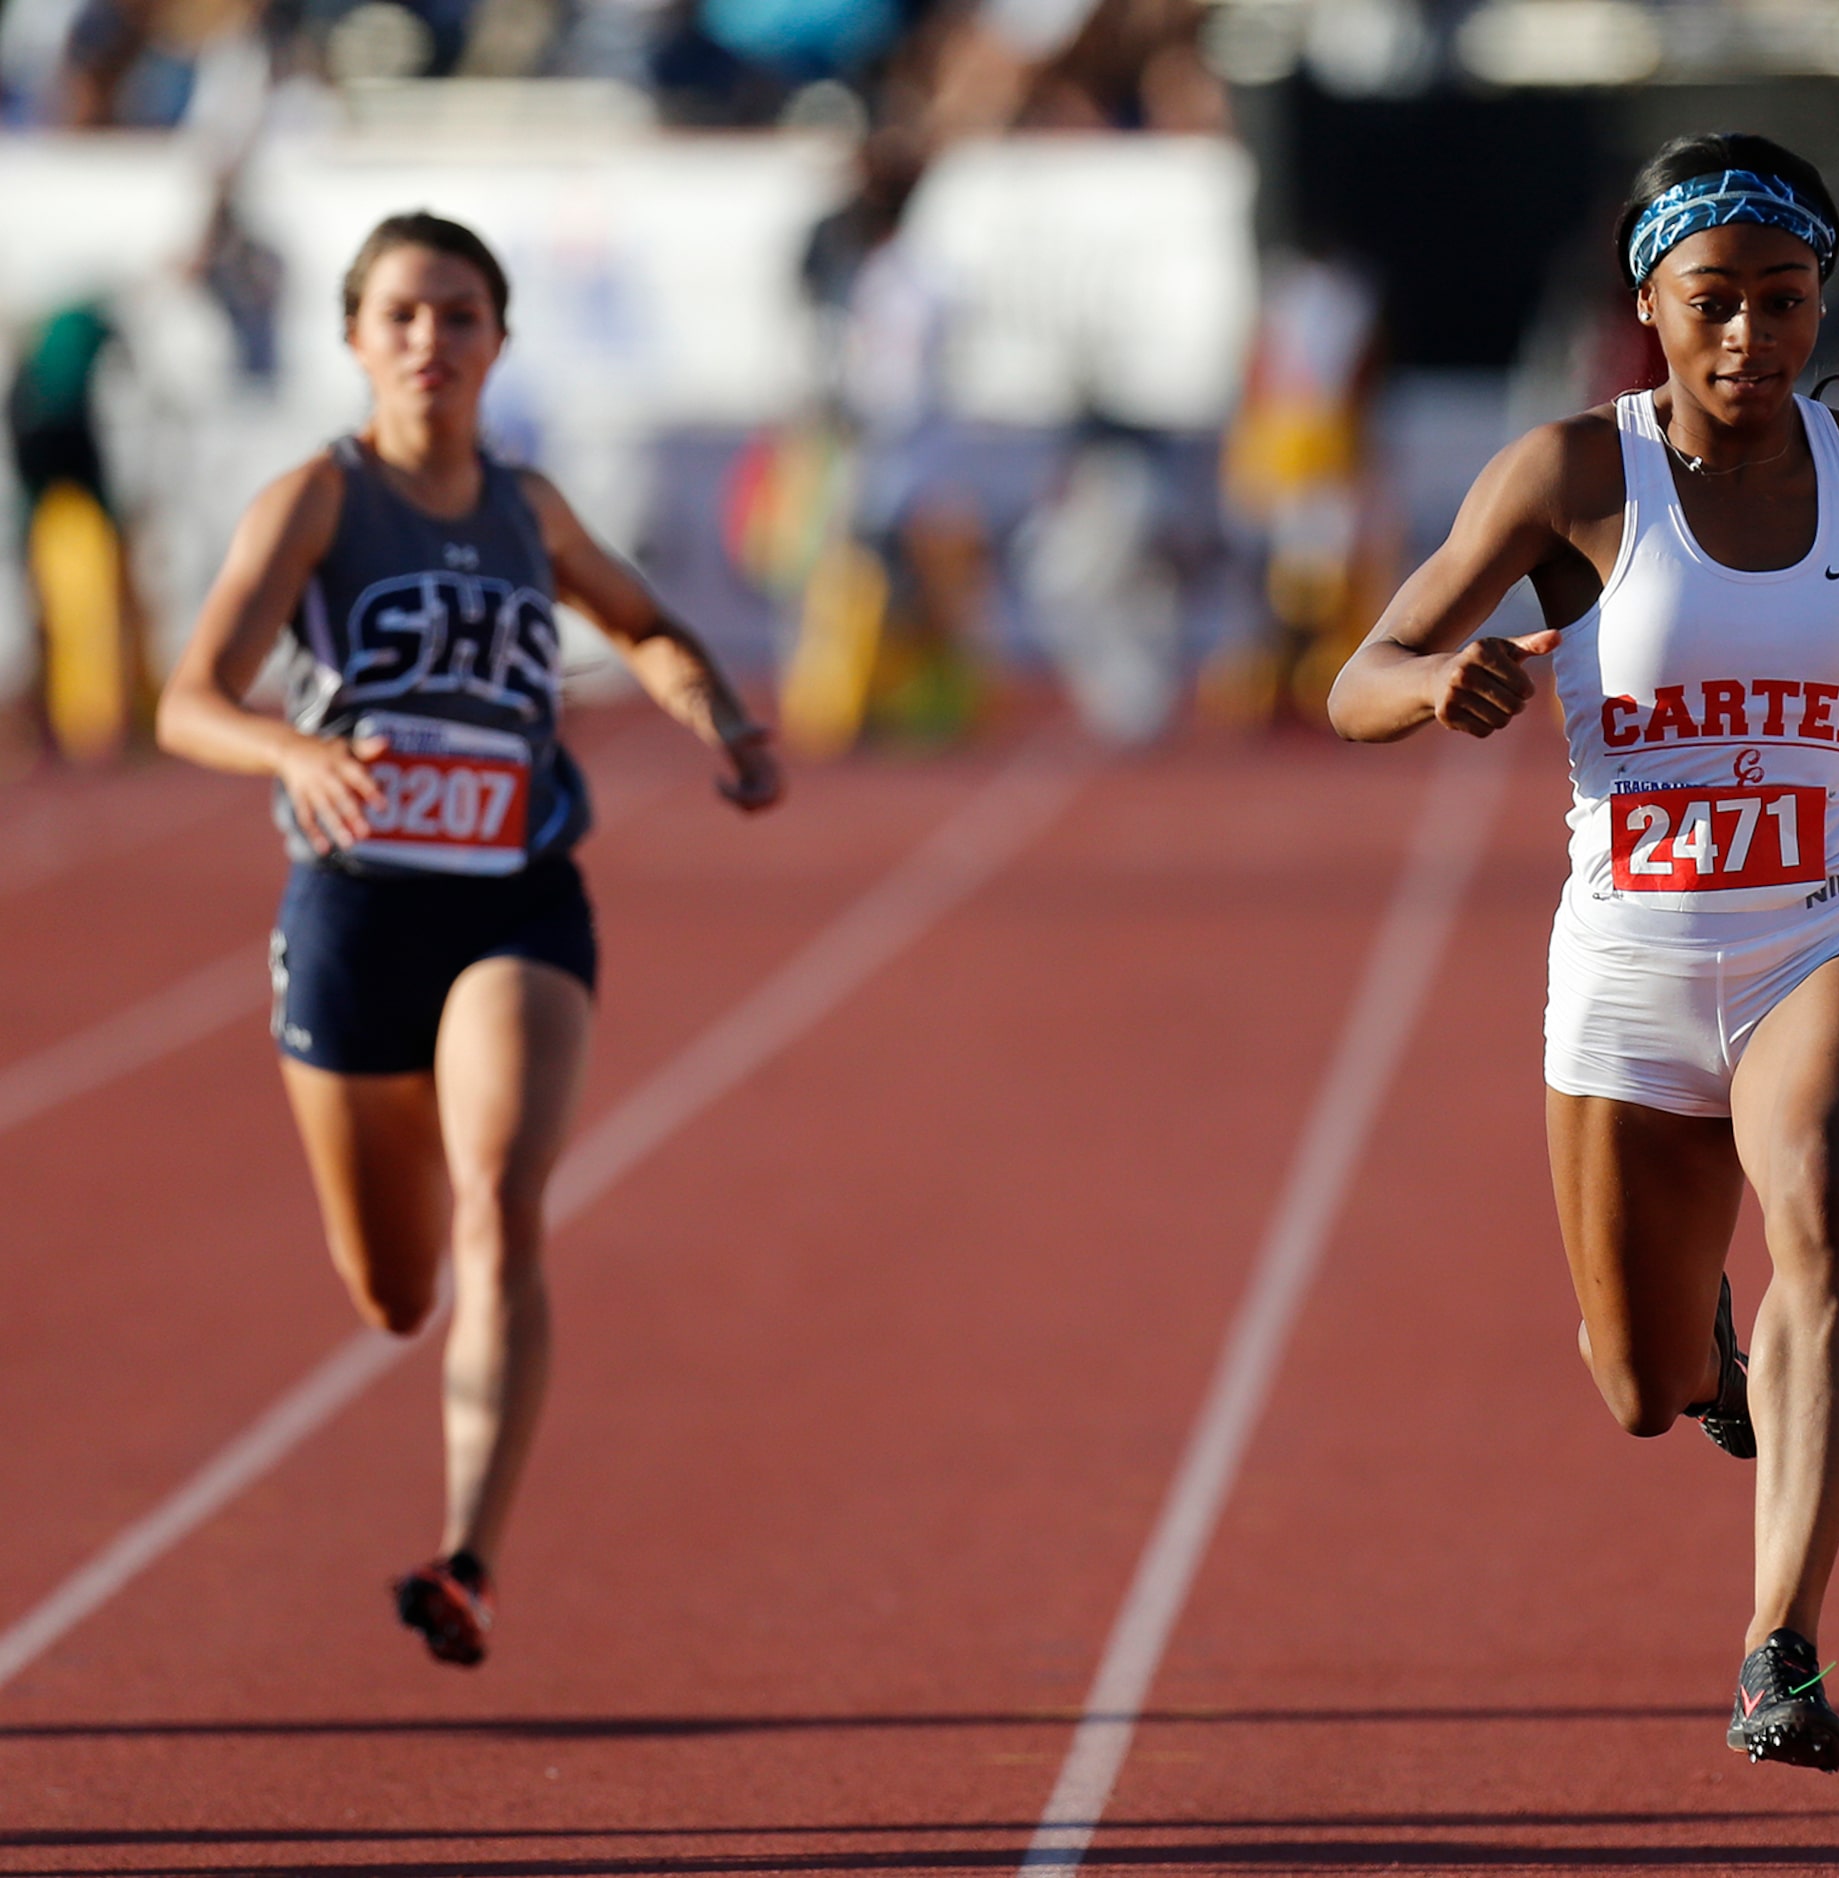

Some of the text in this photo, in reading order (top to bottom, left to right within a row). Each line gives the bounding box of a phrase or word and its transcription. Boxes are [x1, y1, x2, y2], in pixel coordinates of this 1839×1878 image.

[343, 569, 562, 721] SHS
[366, 762, 517, 841] 3207
[1626, 794, 1801, 876] 2471
